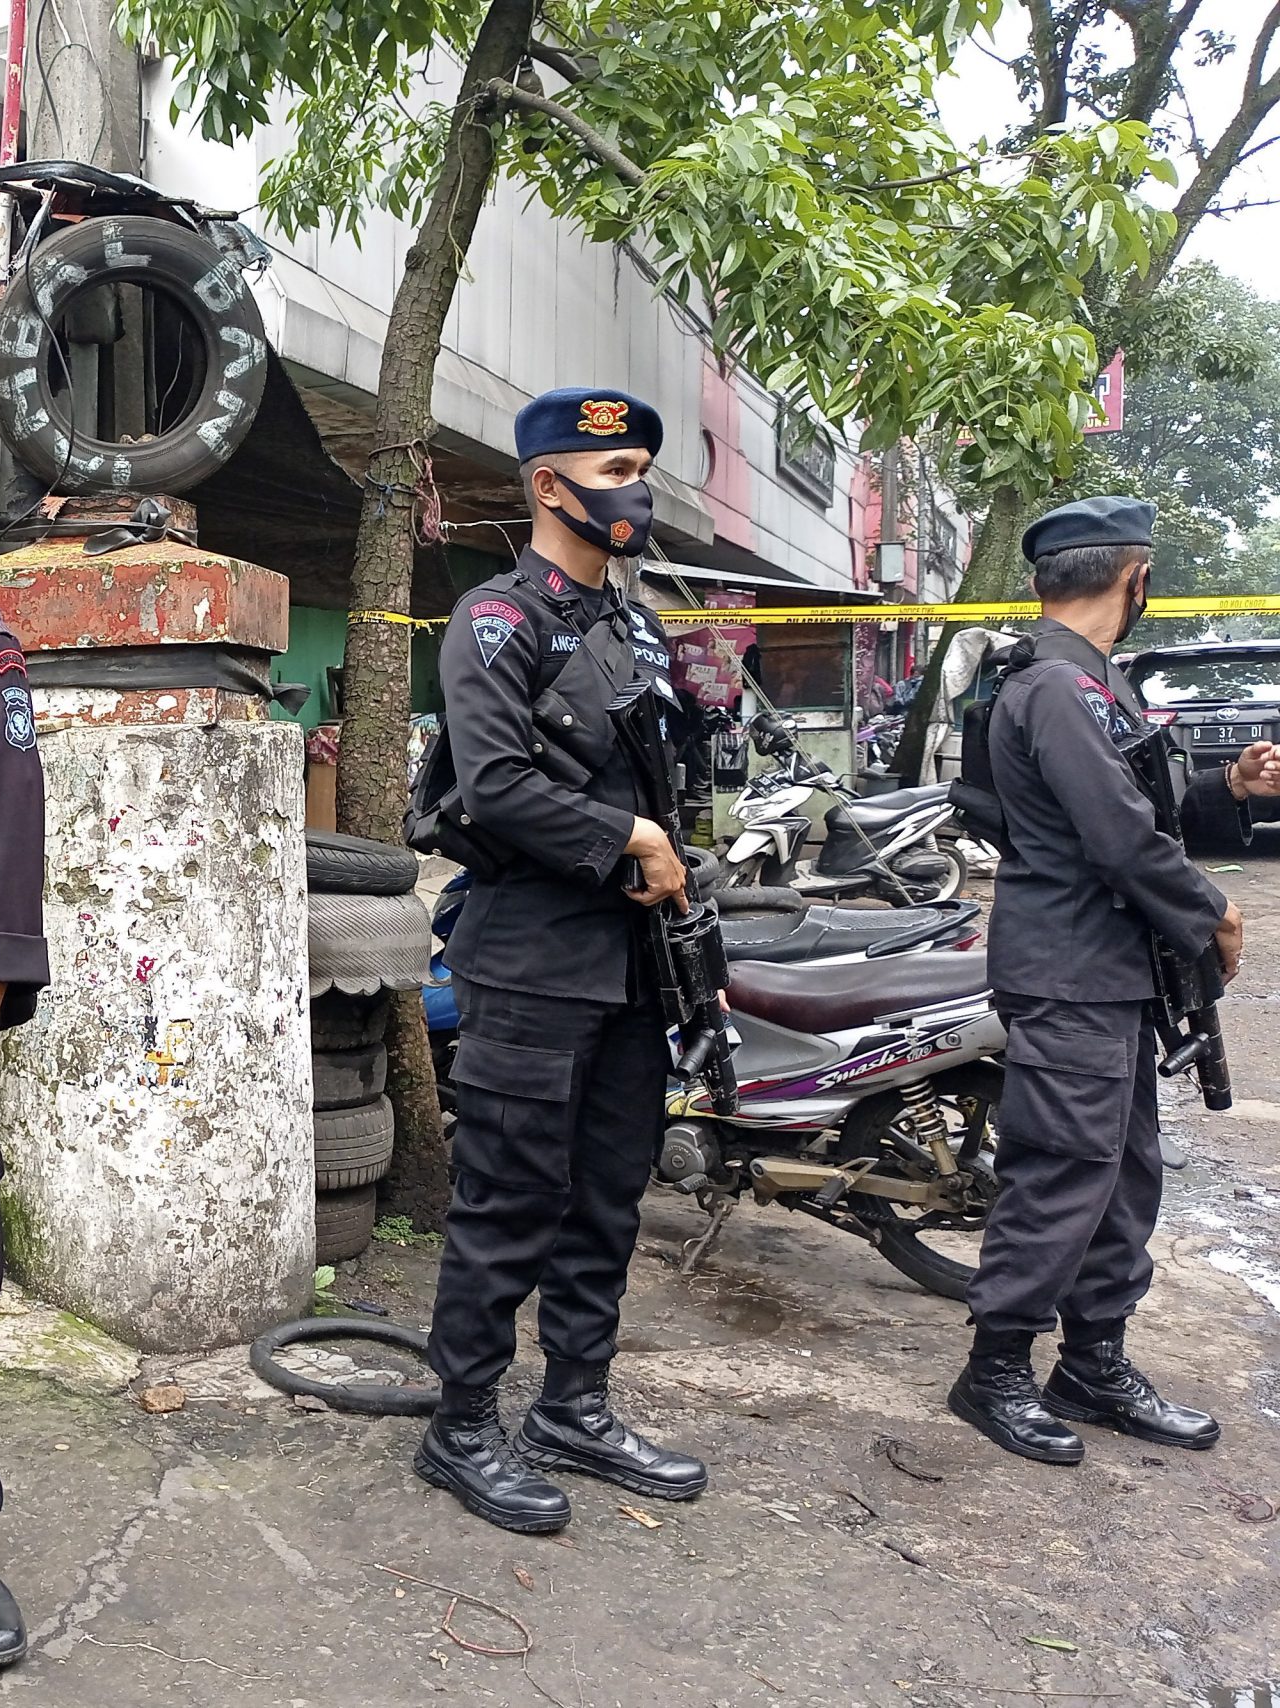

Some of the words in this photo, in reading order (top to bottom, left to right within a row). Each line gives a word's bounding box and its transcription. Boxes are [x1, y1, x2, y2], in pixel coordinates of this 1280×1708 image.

[610, 539, 625, 549] TNI
[474, 603, 519, 622] PELOPOR
[632, 646, 669, 669] POLRI
[1193, 728, 1201, 740] D
[1218, 727, 1234, 738] 37
[811, 1050, 902, 1093] Smash
